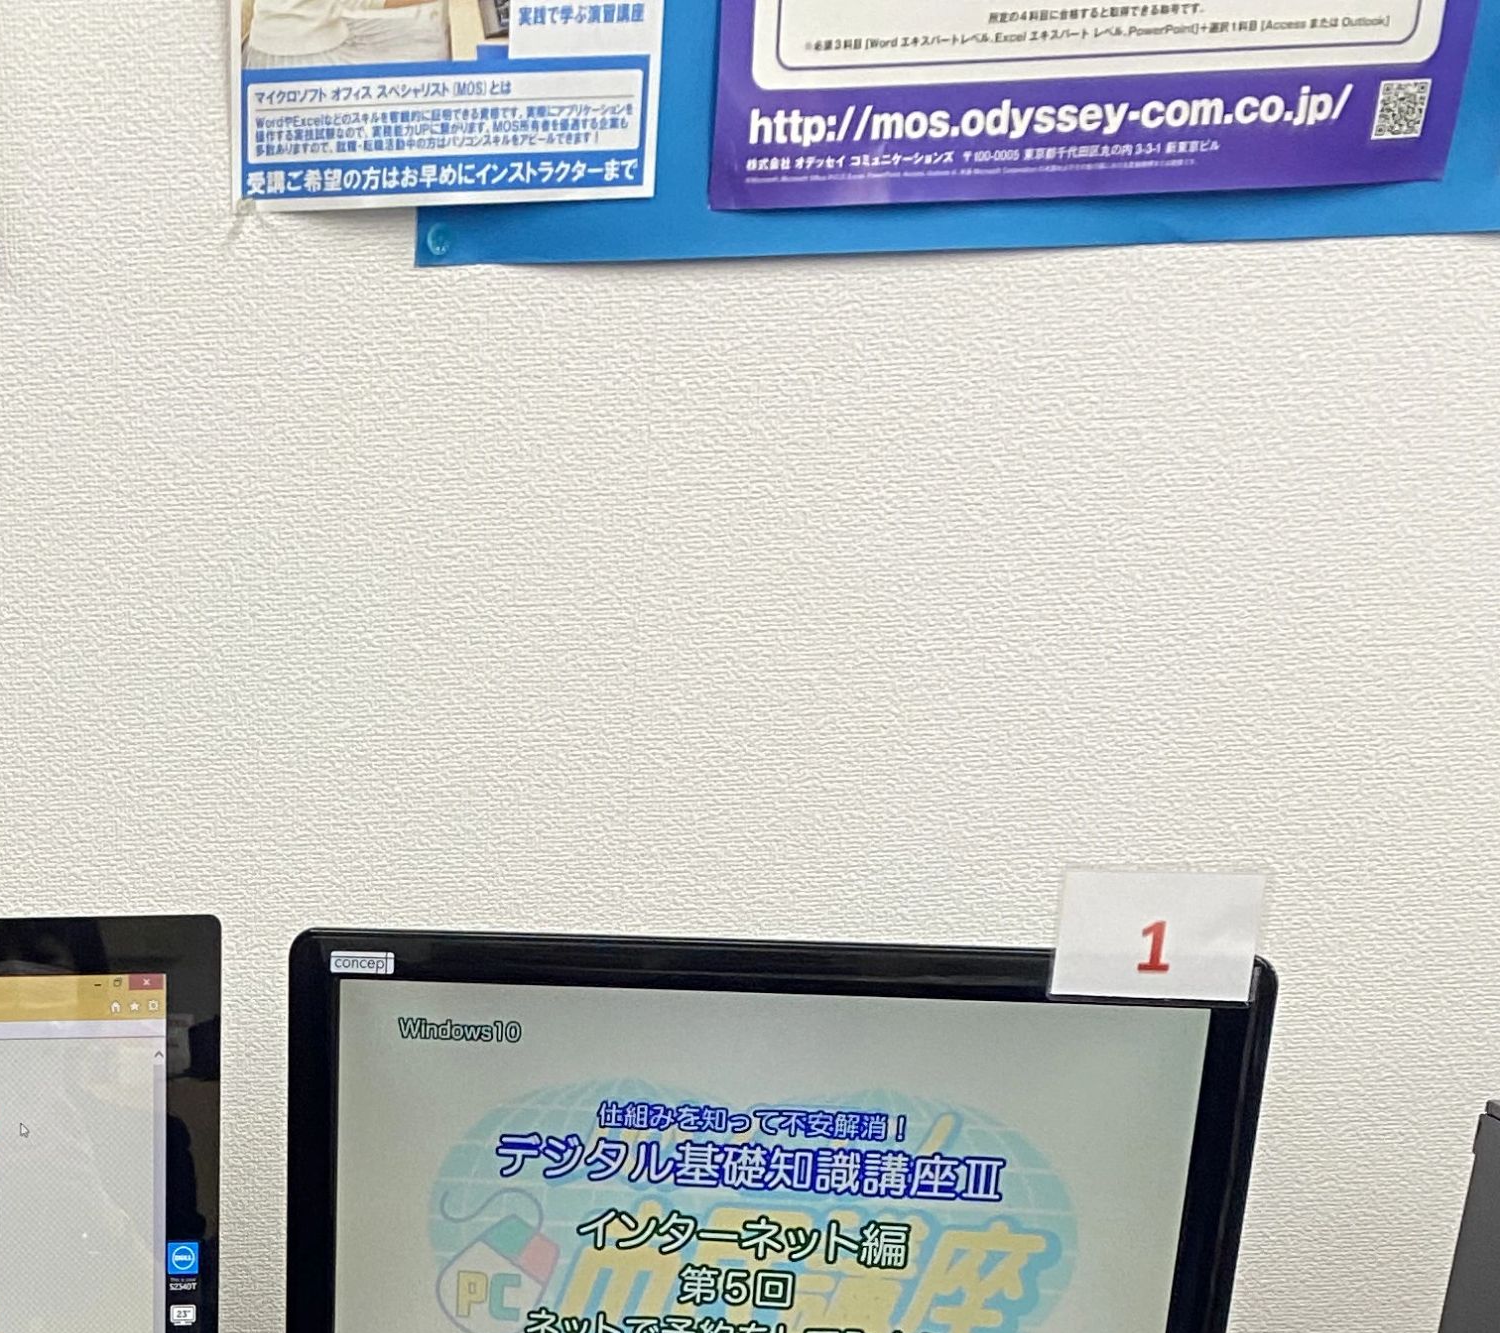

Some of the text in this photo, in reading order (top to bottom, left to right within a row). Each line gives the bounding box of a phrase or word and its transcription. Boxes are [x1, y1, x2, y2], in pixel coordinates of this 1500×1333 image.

[748, 83, 1355, 147] http://mos.odyssey-com.co.jp/
[246, 157, 639, 196] 受講ご希望の方はお早めにインストラクターまで
[1137, 919, 1170, 973] 1
[398, 1016, 522, 1043] Windows10
[598, 1100, 908, 1142] 仕組みを知って不安解消!
[578, 1208, 910, 1270] インターネット編
[678, 1264, 796, 1309] 第5回
